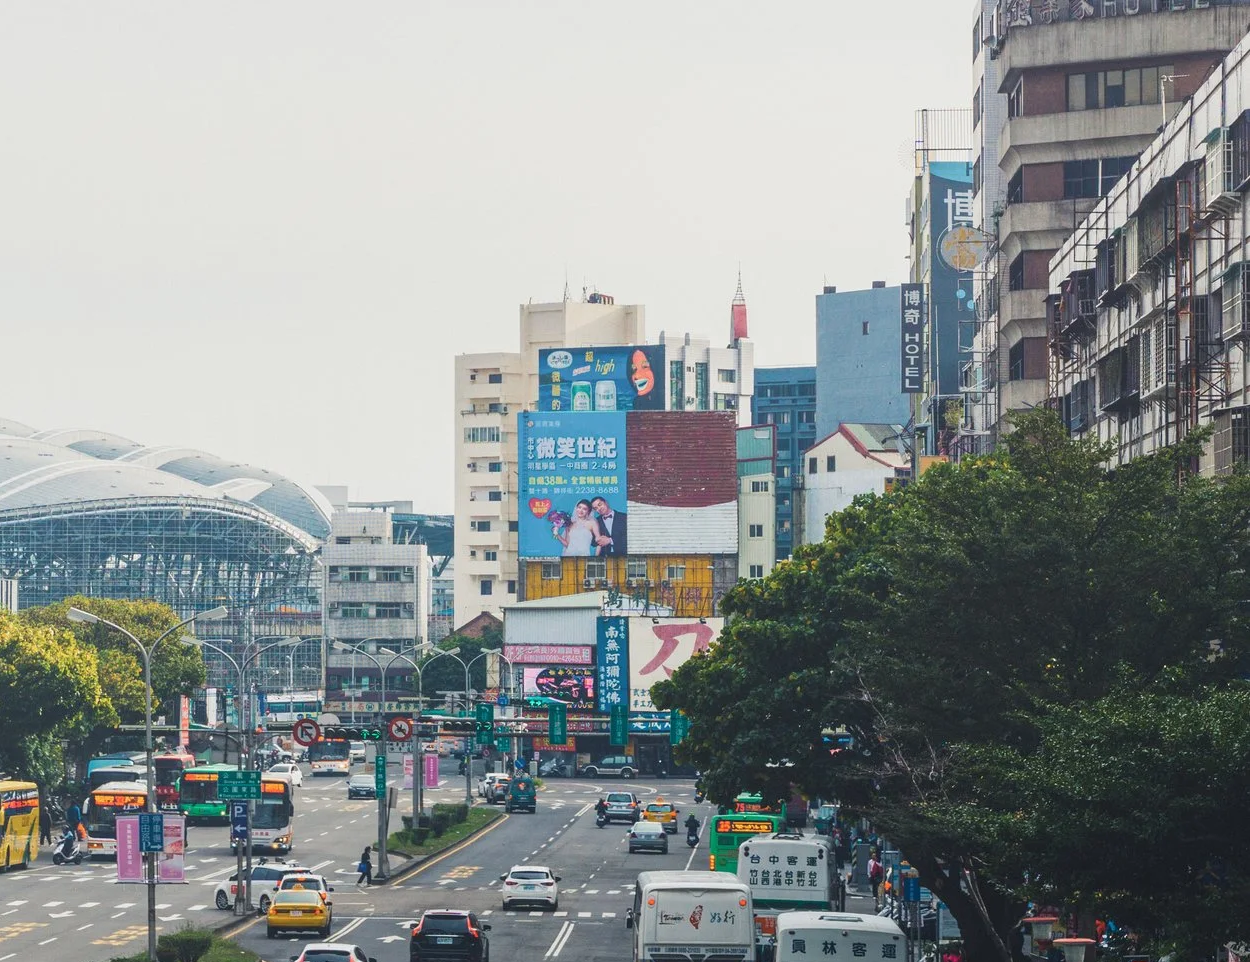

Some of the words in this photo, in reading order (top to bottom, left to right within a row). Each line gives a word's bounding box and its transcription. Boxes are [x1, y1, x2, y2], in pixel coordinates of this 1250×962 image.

[904, 290, 920, 325] 博奇
[594, 358, 615, 375] high
[905, 333, 919, 389] HOTEL
[536, 437, 617, 460] 微笑世紀
[574, 486, 619, 495] 2238-8688
[604, 626, 620, 705] 南無阿彌陀佛
[750, 854, 818, 867] 台中客運
[710, 910, 736, 925] 好行
[791, 938, 898, 960] 員林客運
